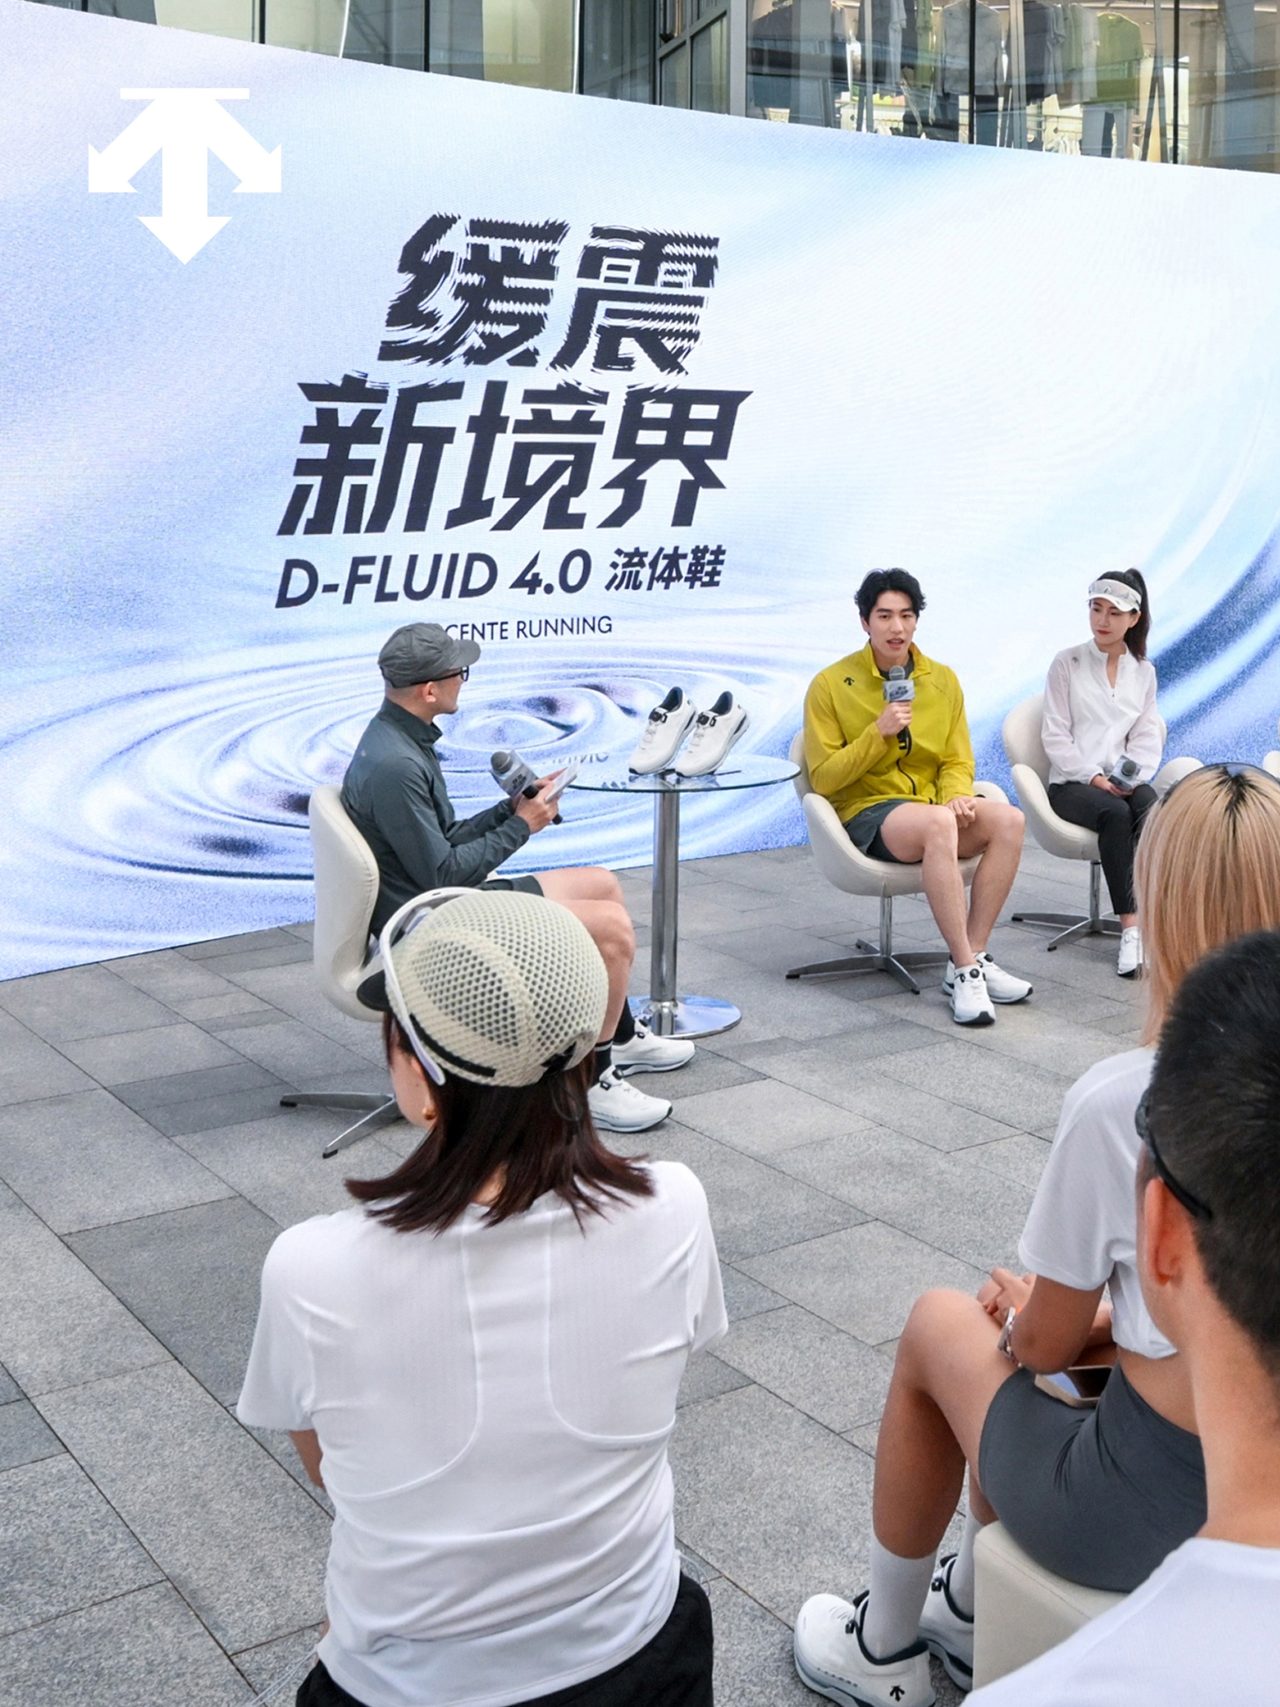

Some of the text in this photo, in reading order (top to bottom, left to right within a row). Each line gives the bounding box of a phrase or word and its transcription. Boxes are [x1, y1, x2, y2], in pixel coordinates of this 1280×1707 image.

[377, 213, 720, 377] 缓震
[276, 370, 754, 537] 新境界
[274, 544, 728, 609] D-FLUID 4.0 流体鞋
[445, 615, 613, 641] CENTE RUNNING
